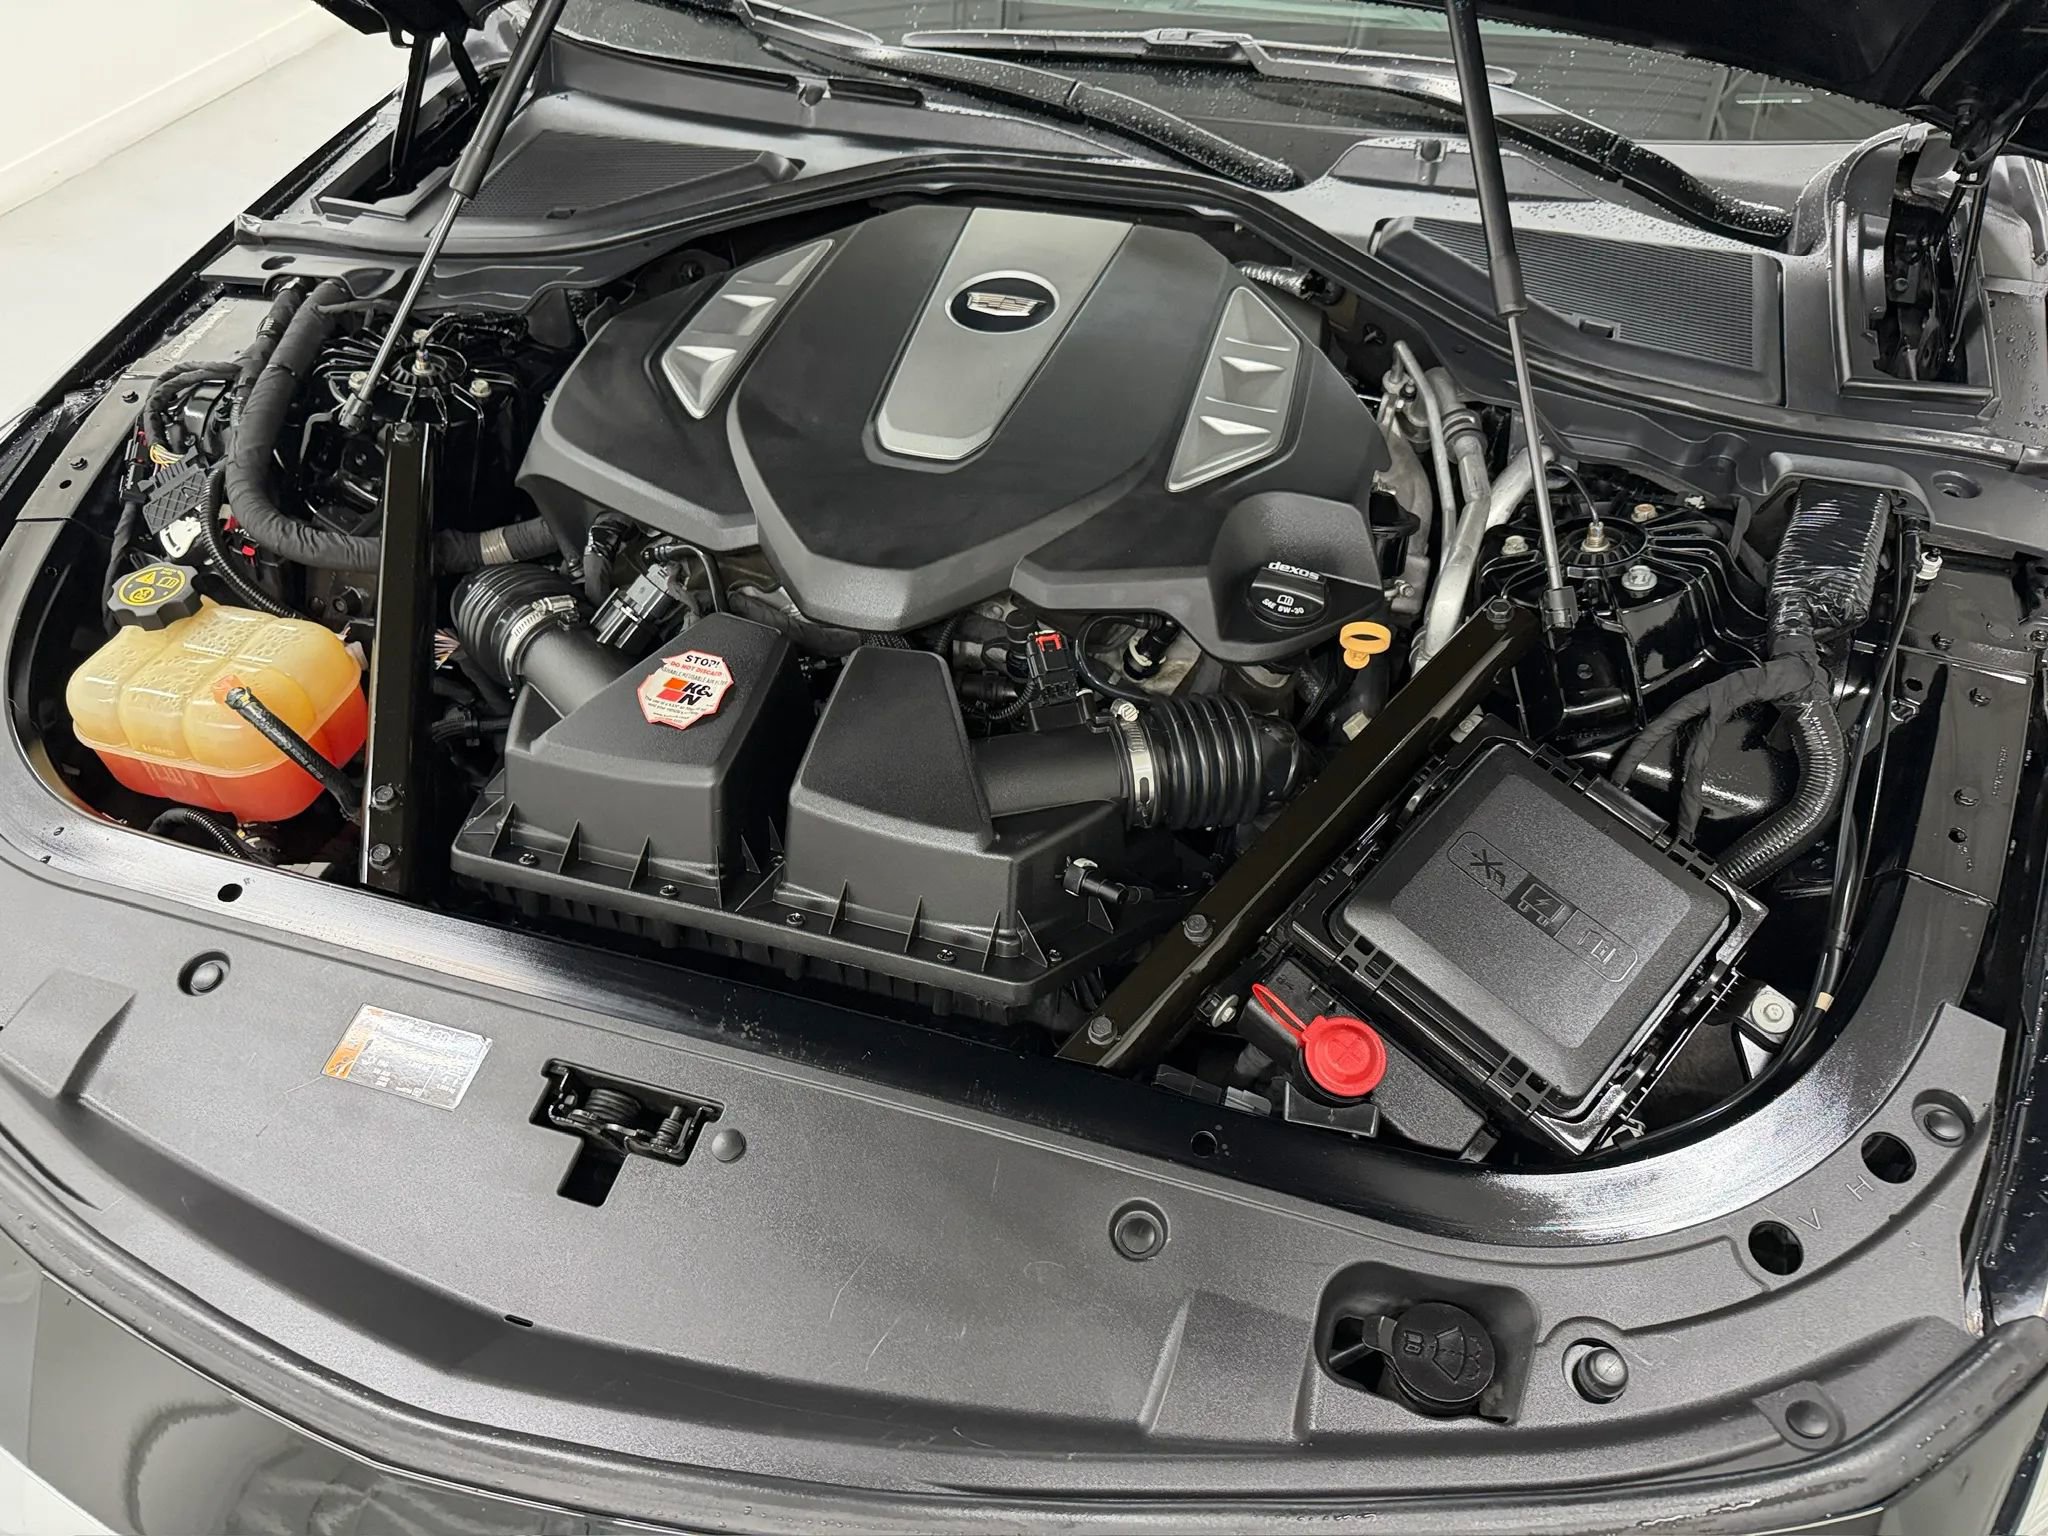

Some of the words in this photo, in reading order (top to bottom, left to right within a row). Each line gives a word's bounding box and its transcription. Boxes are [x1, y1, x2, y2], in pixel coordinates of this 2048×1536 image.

[1268, 561, 1320, 580] dexos
[1261, 598, 1277, 609] SAE
[685, 655, 721, 669] STOP!
[1845, 1175, 1874, 1201] H
[1797, 1207, 1822, 1230] V
